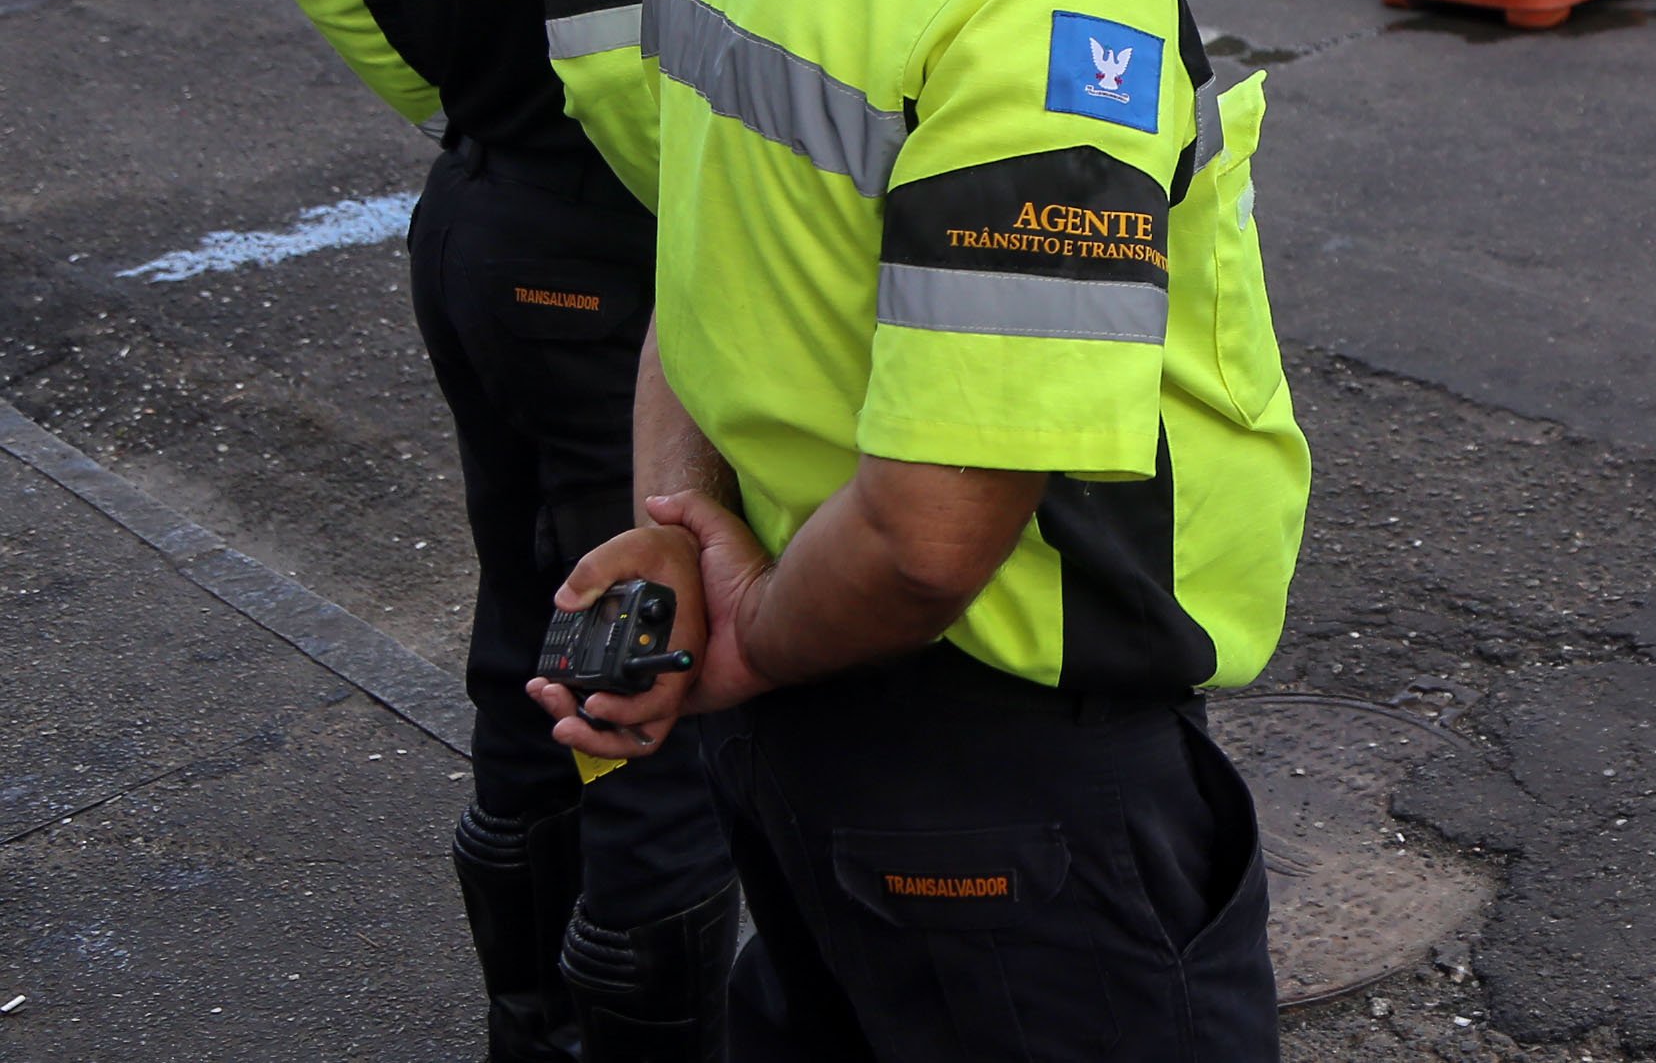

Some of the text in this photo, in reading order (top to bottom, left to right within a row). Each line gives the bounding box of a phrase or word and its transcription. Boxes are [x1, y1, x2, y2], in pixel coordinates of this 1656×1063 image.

[1013, 202, 1153, 241] AGENTE
[947, 227, 1060, 254] TRÂNSITO
[1064, 240, 1073, 255] E
[515, 287, 600, 311] TRANSALVADOR
[885, 875, 1008, 897] TRANSALVADOR
